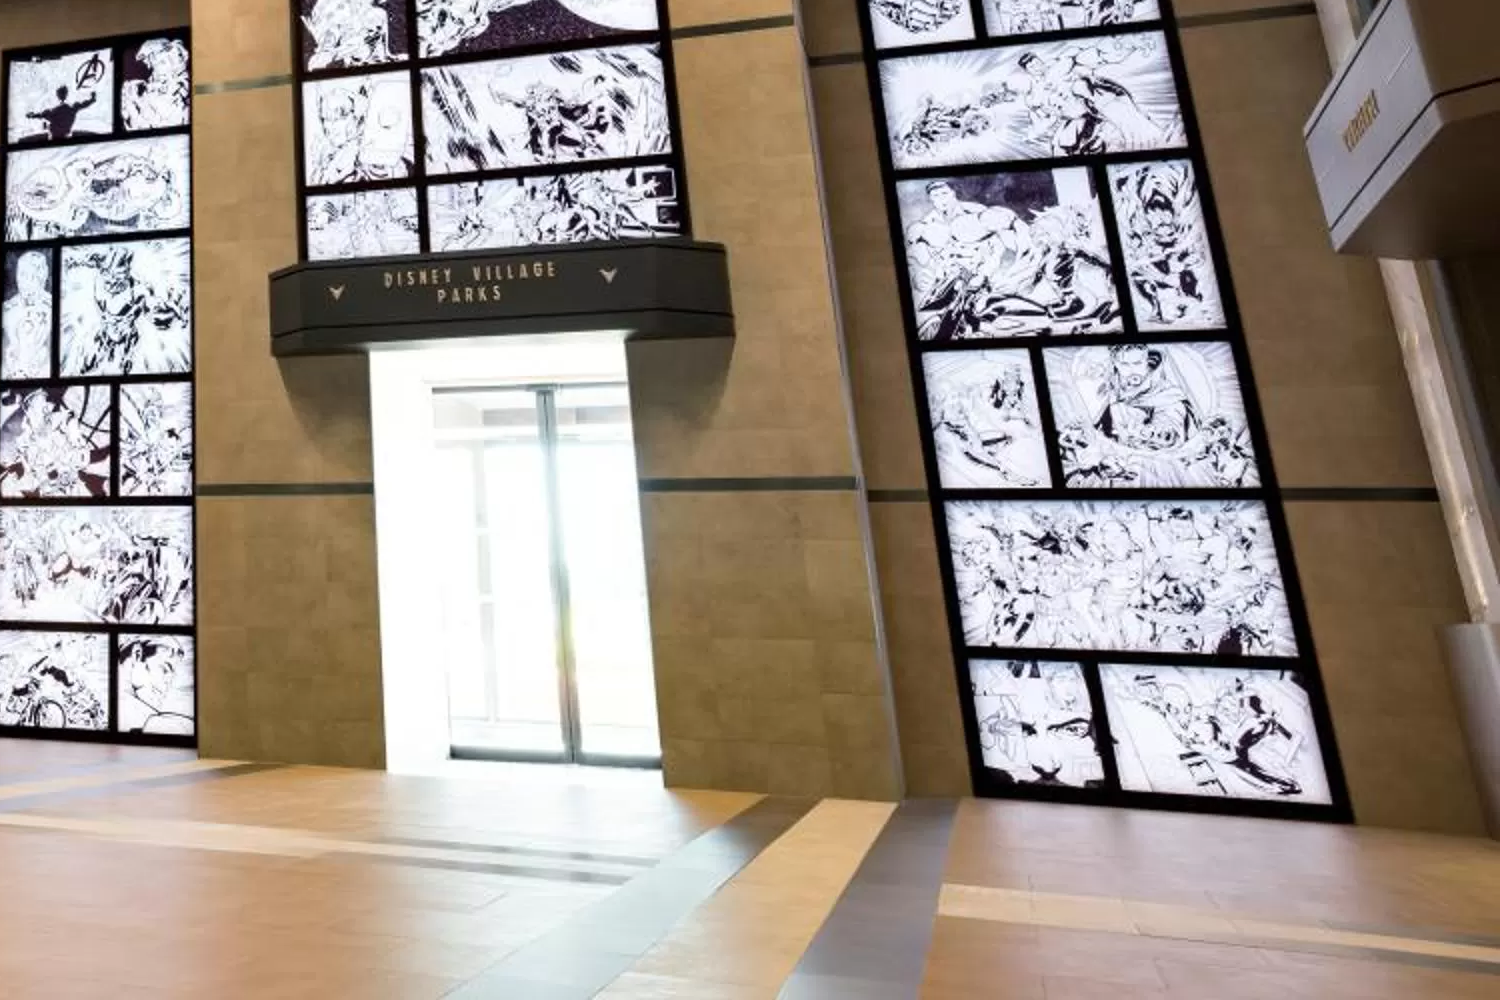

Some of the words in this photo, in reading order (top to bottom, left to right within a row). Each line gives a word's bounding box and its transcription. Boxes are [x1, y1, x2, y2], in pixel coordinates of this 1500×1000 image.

[384, 268, 451, 289] DISNEY
[472, 261, 557, 282] VILLAGE
[437, 285, 501, 304] PARKS
